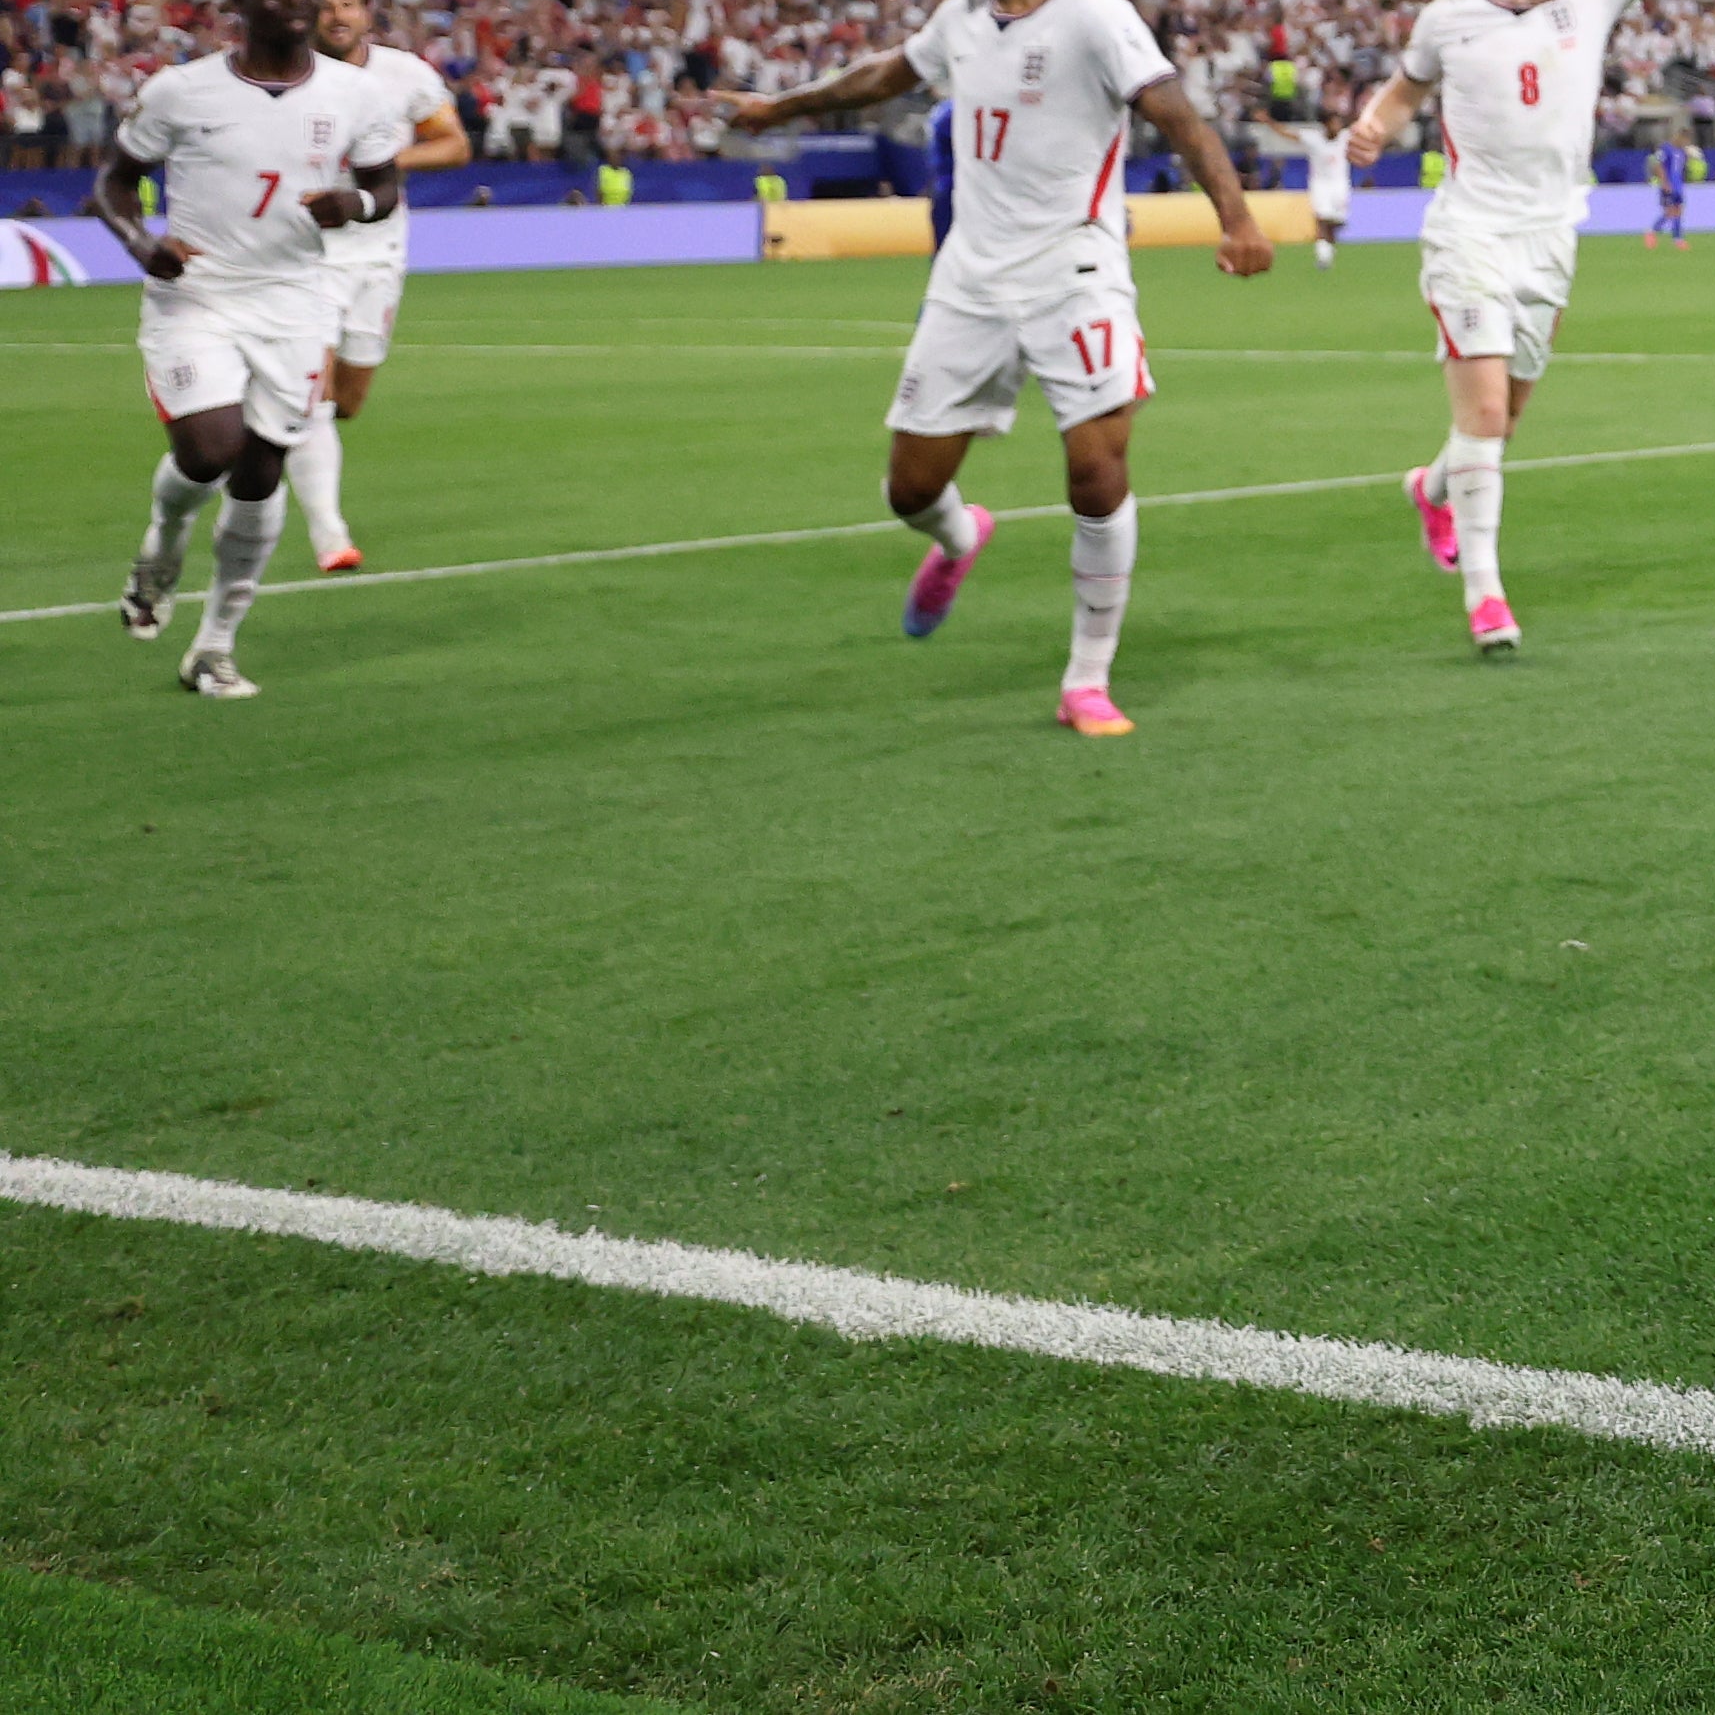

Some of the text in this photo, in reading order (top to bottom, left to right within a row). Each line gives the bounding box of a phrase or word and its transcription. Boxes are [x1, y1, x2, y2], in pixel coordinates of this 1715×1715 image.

[1519, 62, 1539, 106] 8
[974, 105, 1010, 162] 17
[251, 170, 280, 217] 7
[1071, 318, 1113, 375] 17
